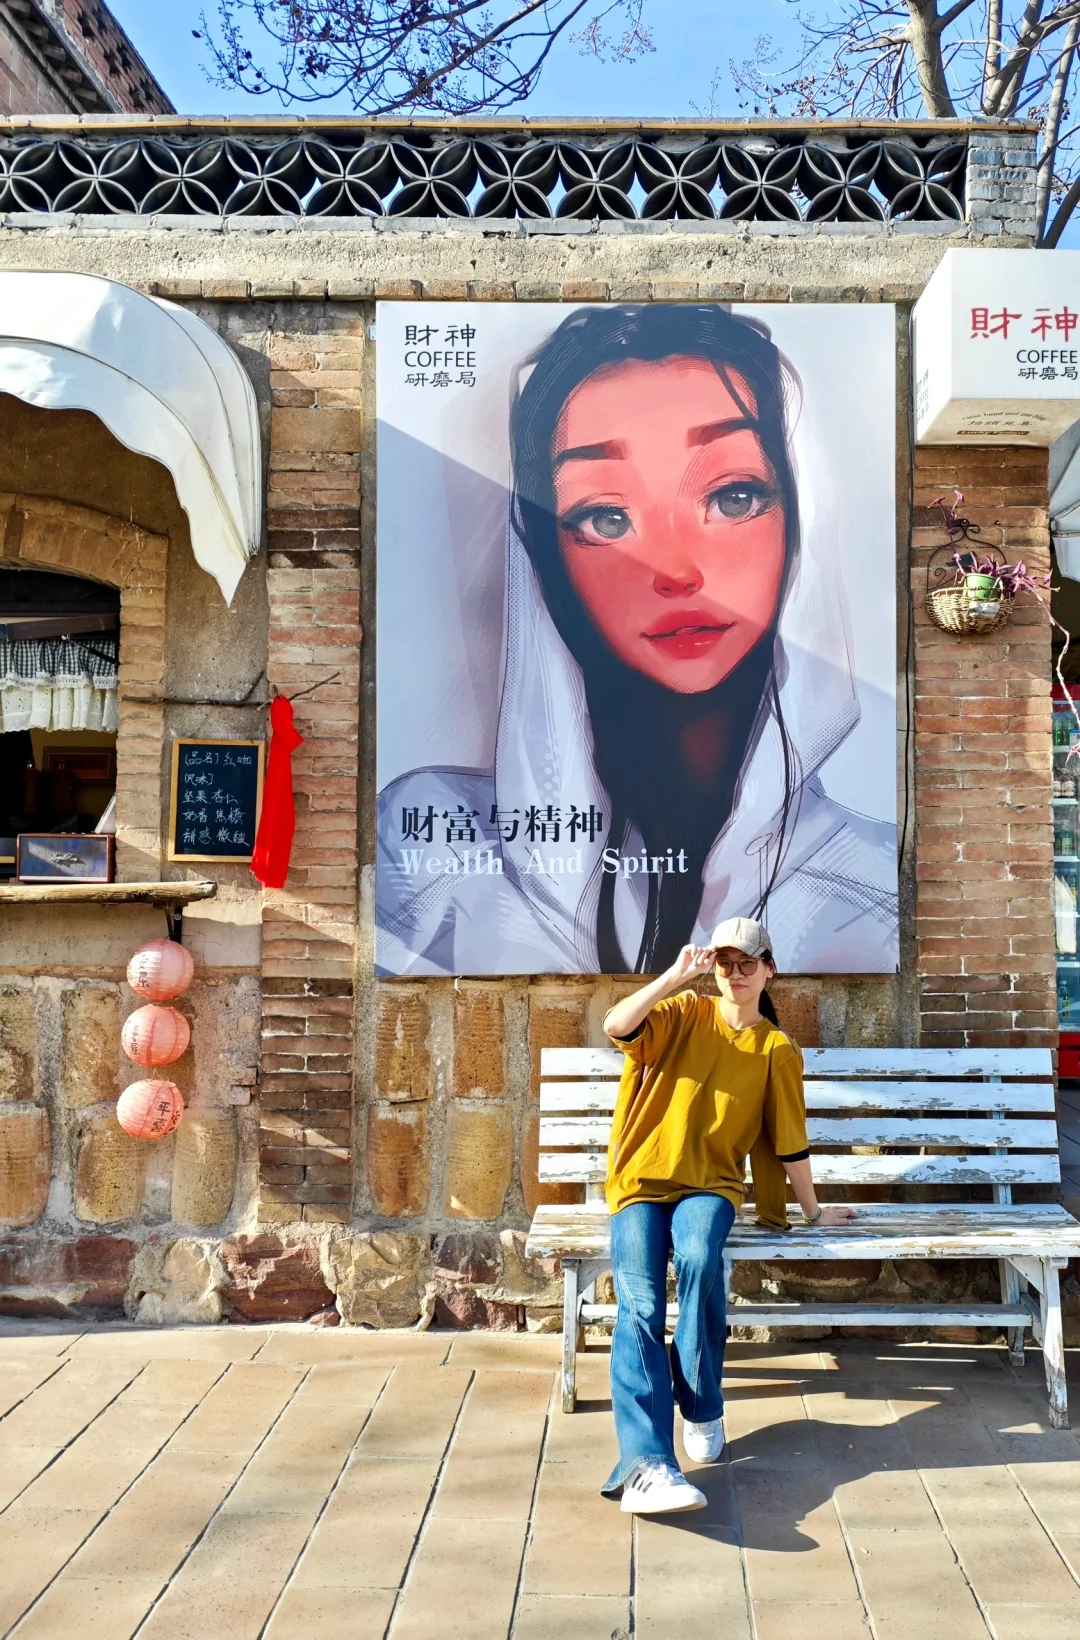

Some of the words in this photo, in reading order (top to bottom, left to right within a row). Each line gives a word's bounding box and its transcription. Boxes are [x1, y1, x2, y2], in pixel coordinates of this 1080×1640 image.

[970, 306, 1079, 342] 財神
[404, 323, 477, 347] 財神
[404, 351, 477, 368] COFFEE
[1016, 350, 1078, 364] COFFEE
[404, 371, 477, 387] 研磨局
[1017, 366, 1078, 380] 研磨局
[401, 804, 604, 843] 财富与精神
[399, 848, 504, 875] Wealth
[523, 848, 584, 874] And
[602, 848, 689, 879] Spirit
